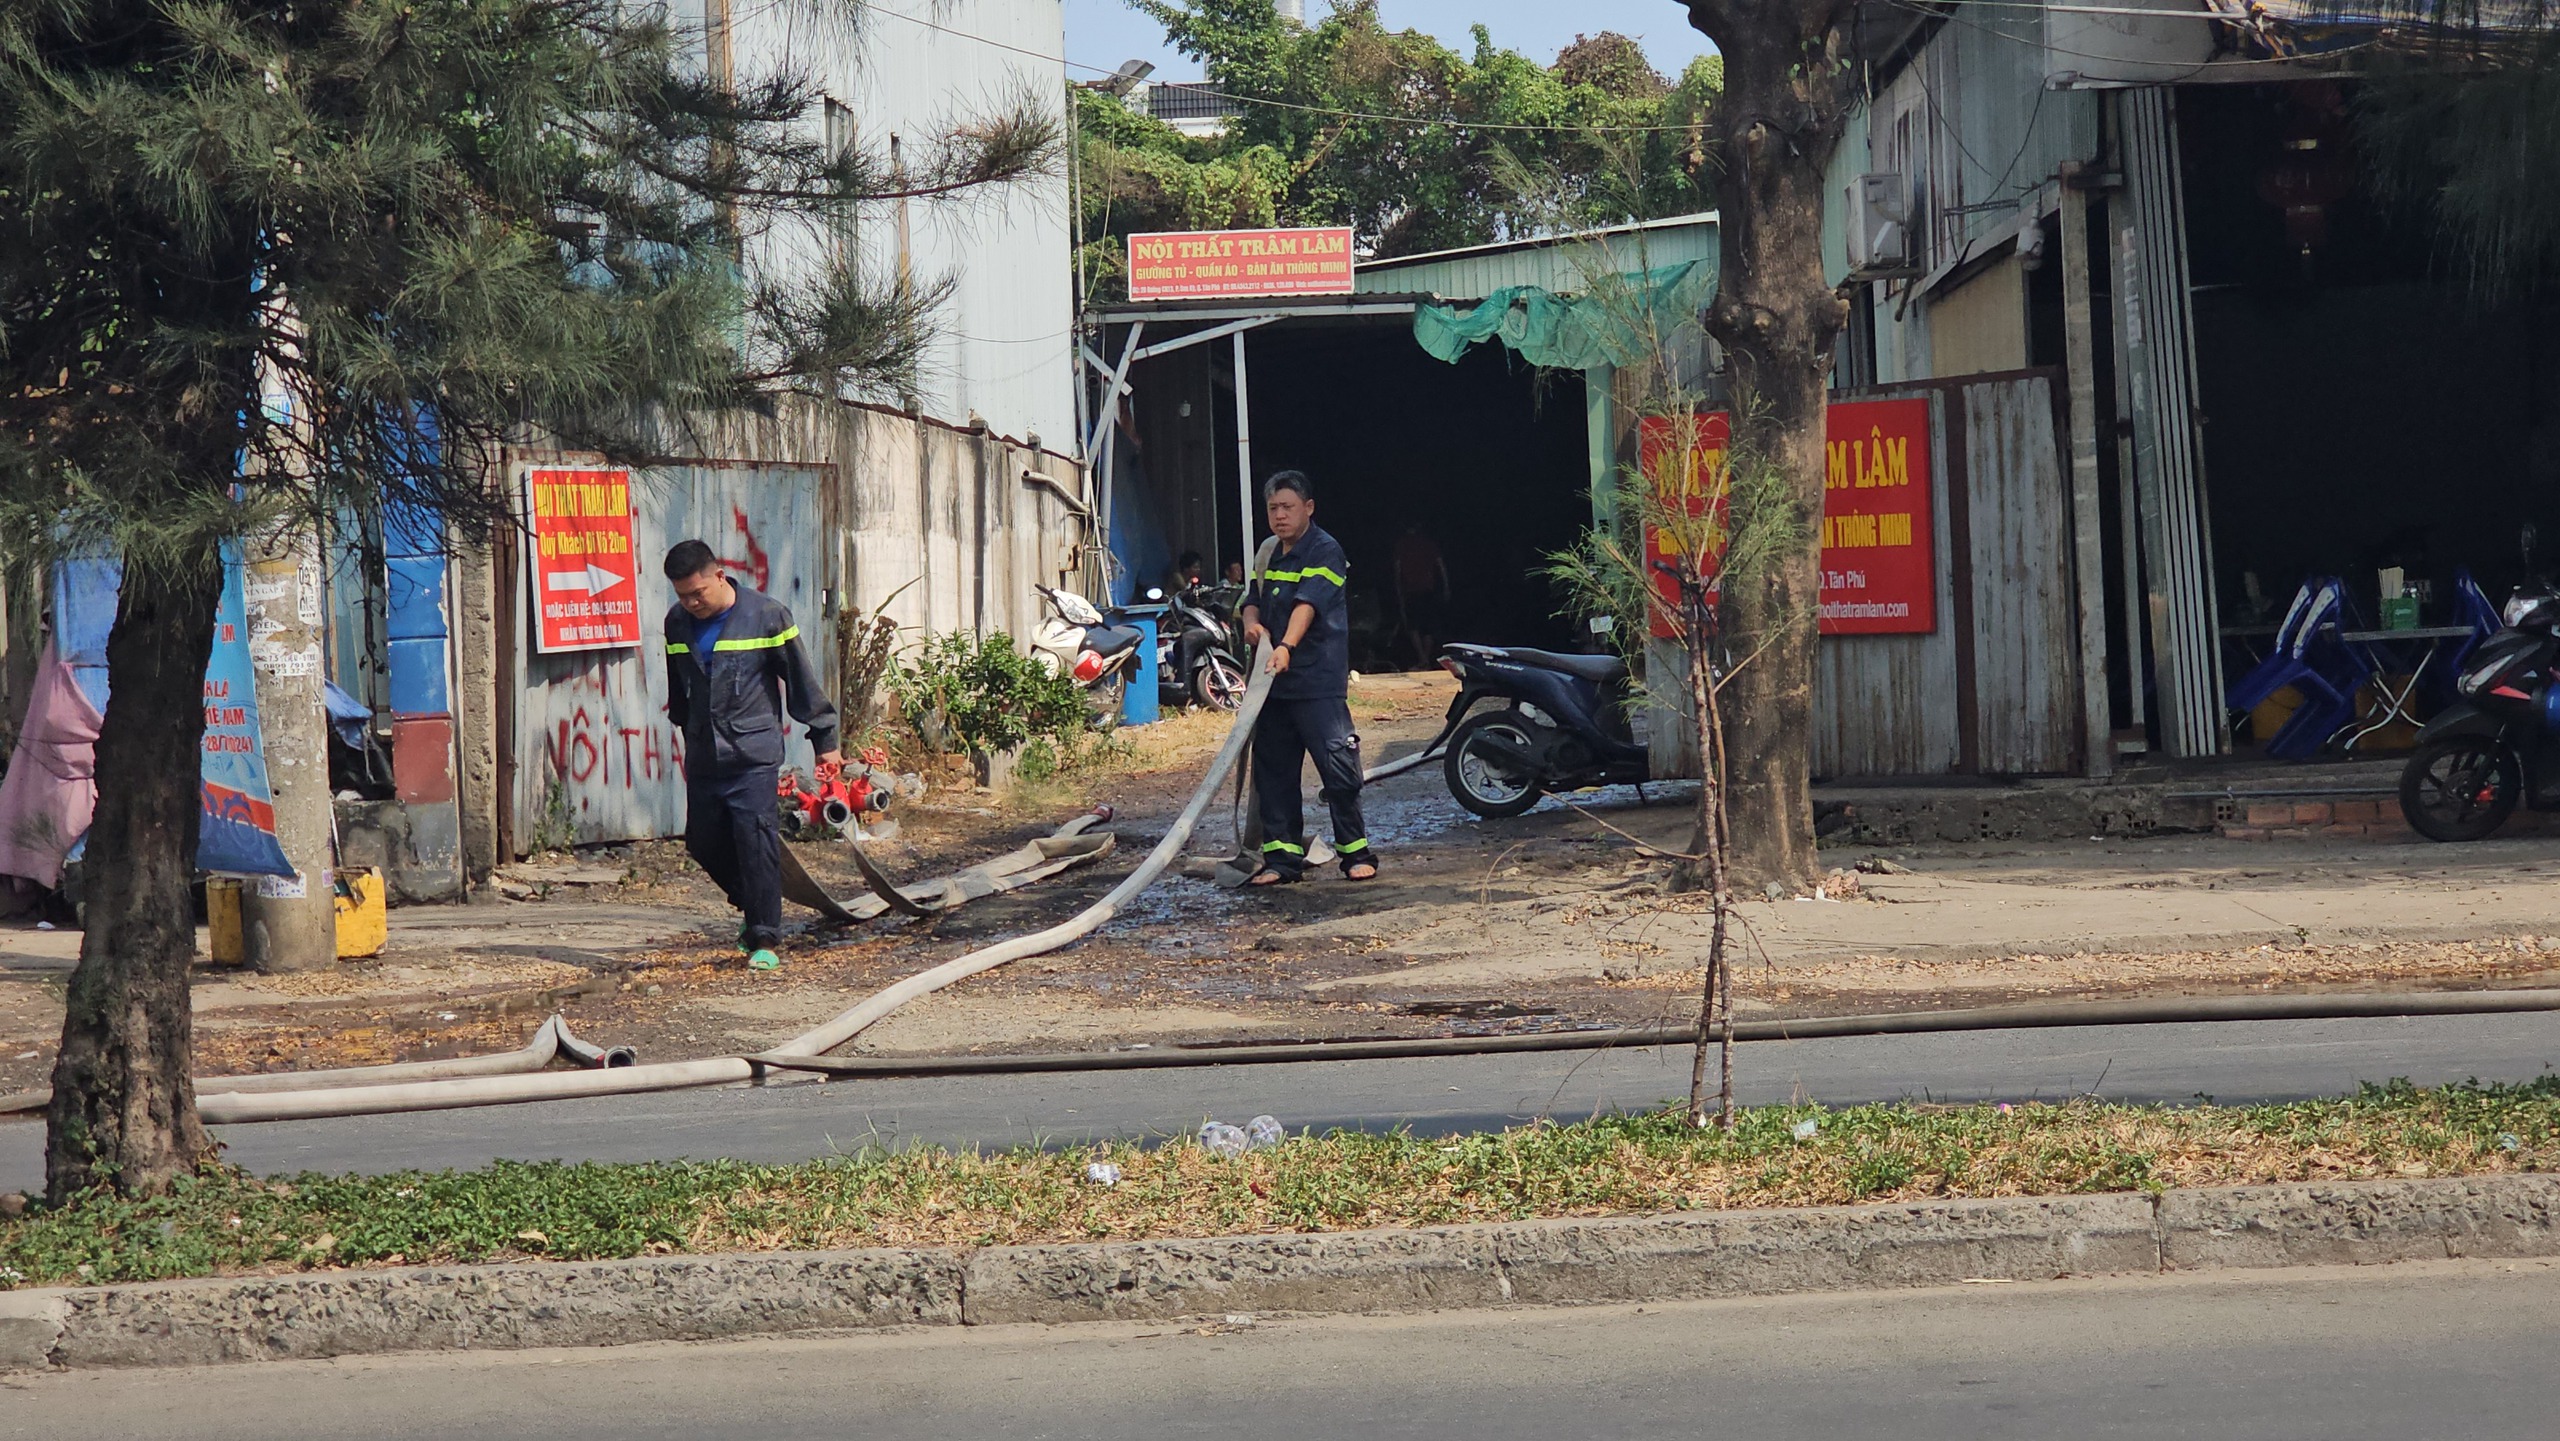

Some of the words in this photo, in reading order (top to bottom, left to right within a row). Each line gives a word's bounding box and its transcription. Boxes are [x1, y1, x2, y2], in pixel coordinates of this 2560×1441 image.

[1136, 238, 1174, 264] NỘI
[1178, 234, 1234, 258] THẤT
[1239, 234, 1297, 256] TRÂM
[1302, 232, 1345, 254] LÂM
[1286, 260, 1318, 275] THÔNG
[1320, 261, 1347, 273] MINH
[1853, 424, 1909, 488] LÂM
[536, 477, 553, 525] NỘI
[553, 473, 578, 517] THẤT
[579, 477, 605, 517] TRÂM
[605, 478, 627, 517] LÂM
[1835, 509, 1877, 548] THÔNG
[1879, 513, 1911, 547] MINH
[540, 532, 556, 560] Quý
[557, 531, 585, 555] Khách
[585, 531, 596, 555] Đi
[608, 531, 627, 554] 20m
[1846, 569, 1866, 589] Phú
[546, 601, 564, 621] HOẶC
[564, 600, 579, 617] LIÊN
[559, 623, 578, 641] NHÂN
[578, 623, 593, 640] VIÊN
